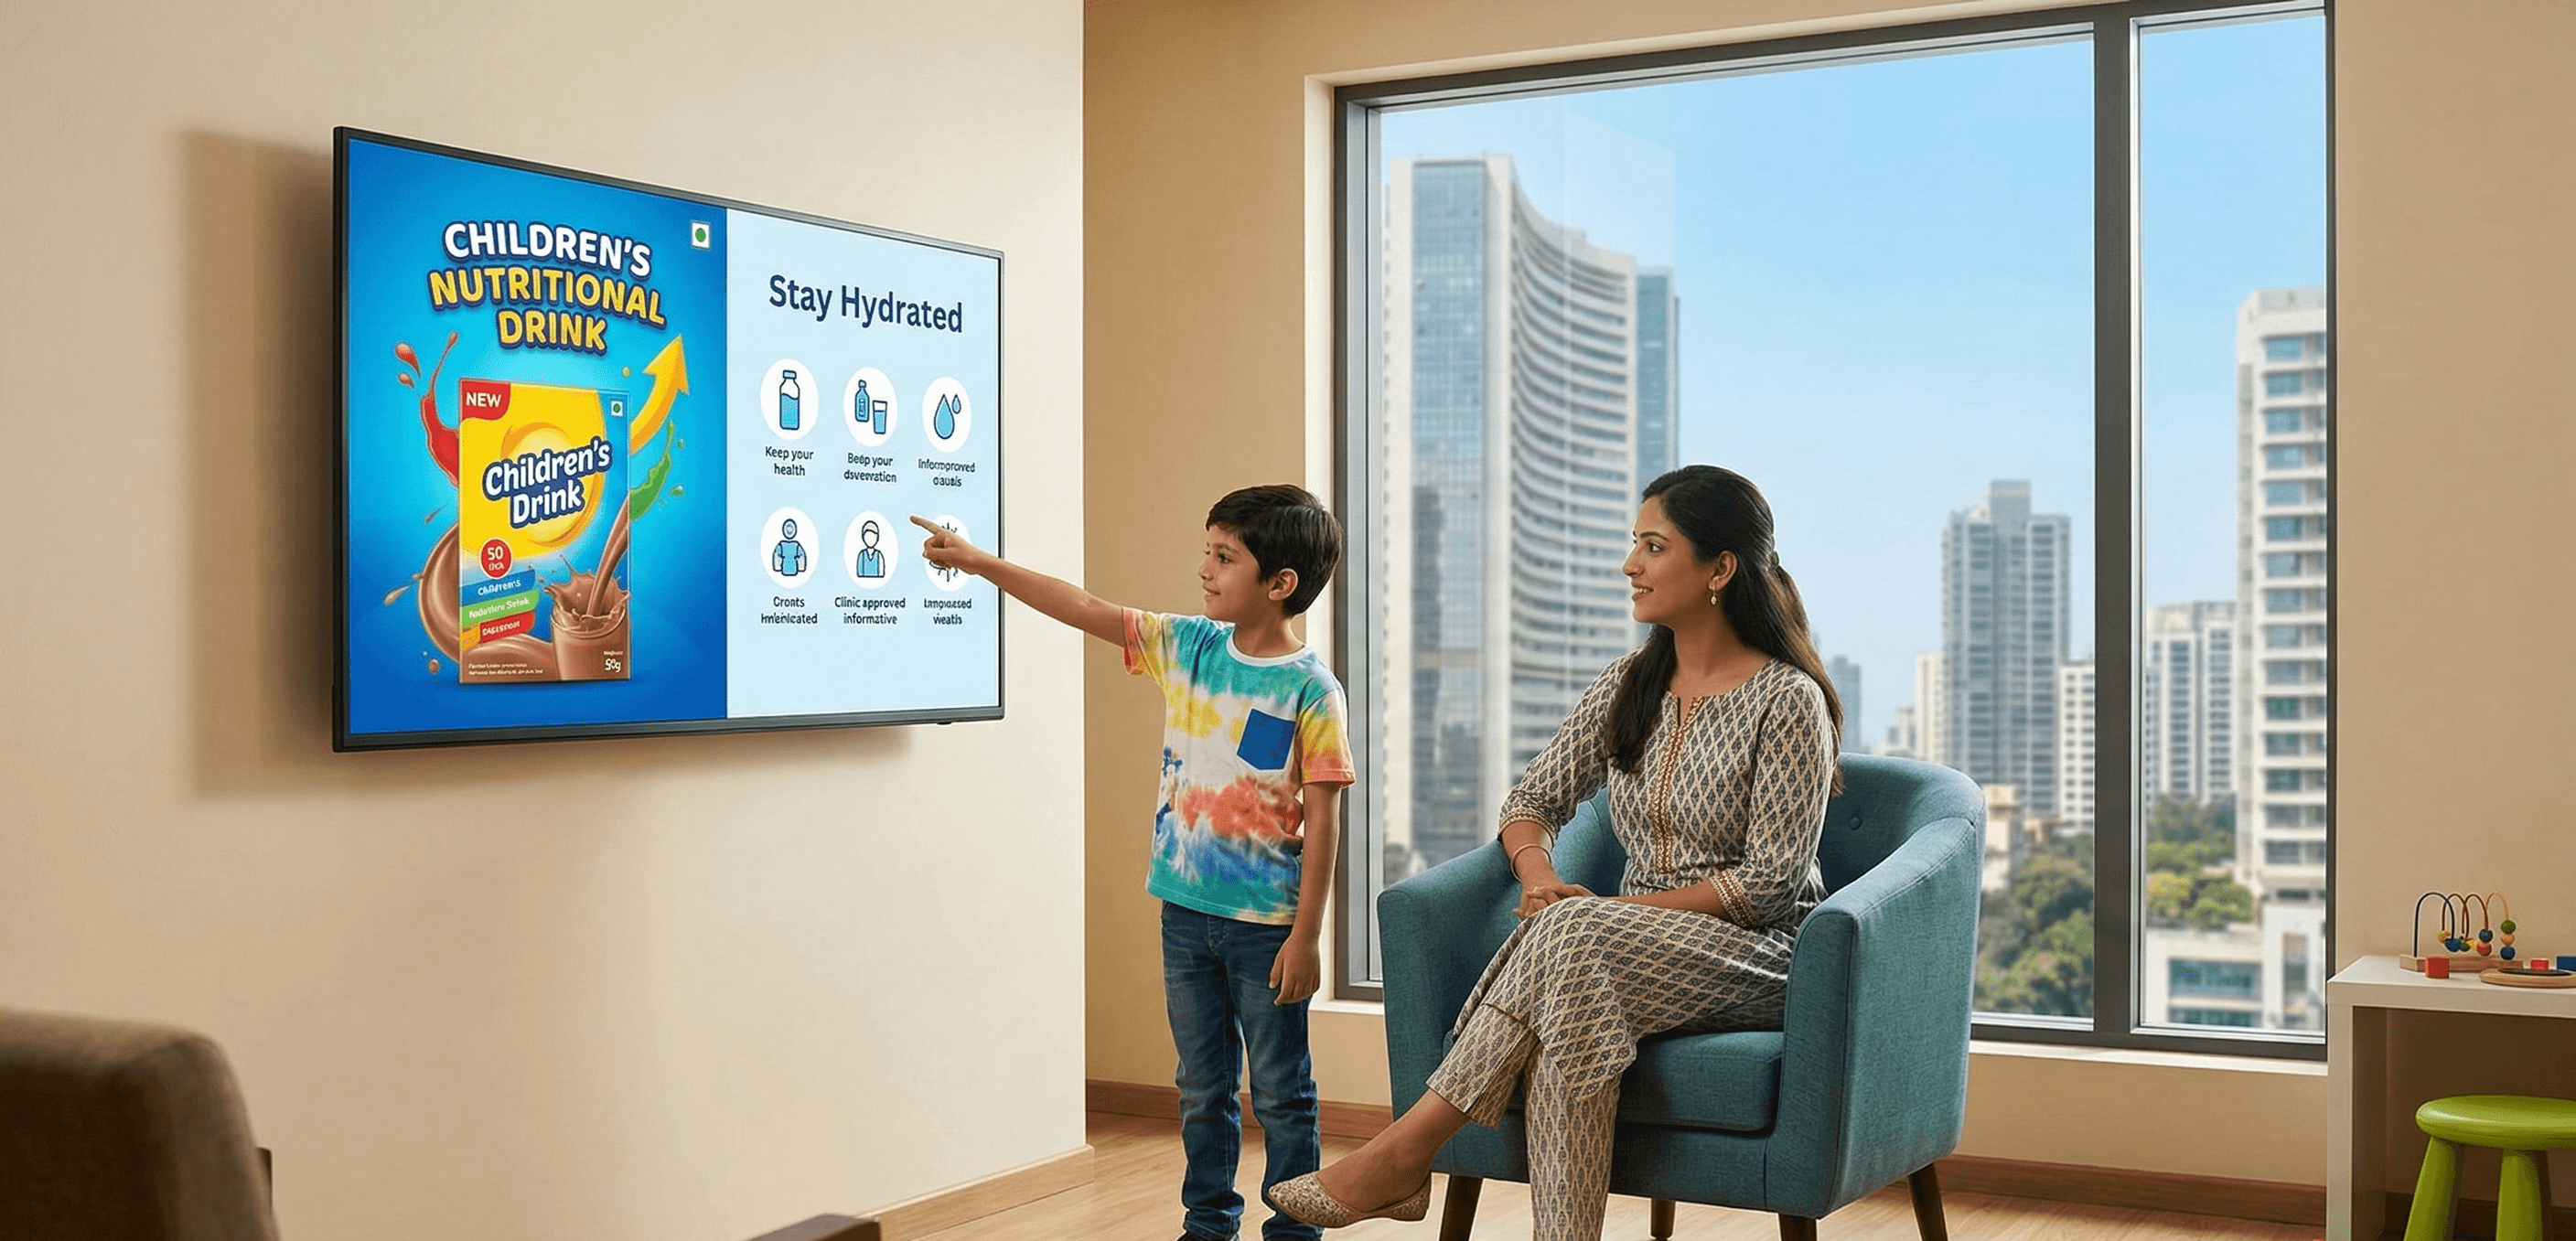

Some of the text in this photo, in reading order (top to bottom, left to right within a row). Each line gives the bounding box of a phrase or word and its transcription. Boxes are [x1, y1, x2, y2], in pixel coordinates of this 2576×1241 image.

[445, 221, 651, 277] CHILDREN'S
[429, 267, 665, 325] NUTRITIONAL
[769, 274, 962, 333] Stay Hydrated
[499, 311, 606, 350] DRINK
[466, 391, 501, 408] NEW
[765, 445, 814, 462] Keep your
[872, 456, 894, 468] your
[485, 439, 611, 497] Children's
[774, 463, 806, 476] health
[512, 479, 583, 524] Drink
[487, 545, 504, 561] 50
[834, 595, 907, 611] Clinic approved
